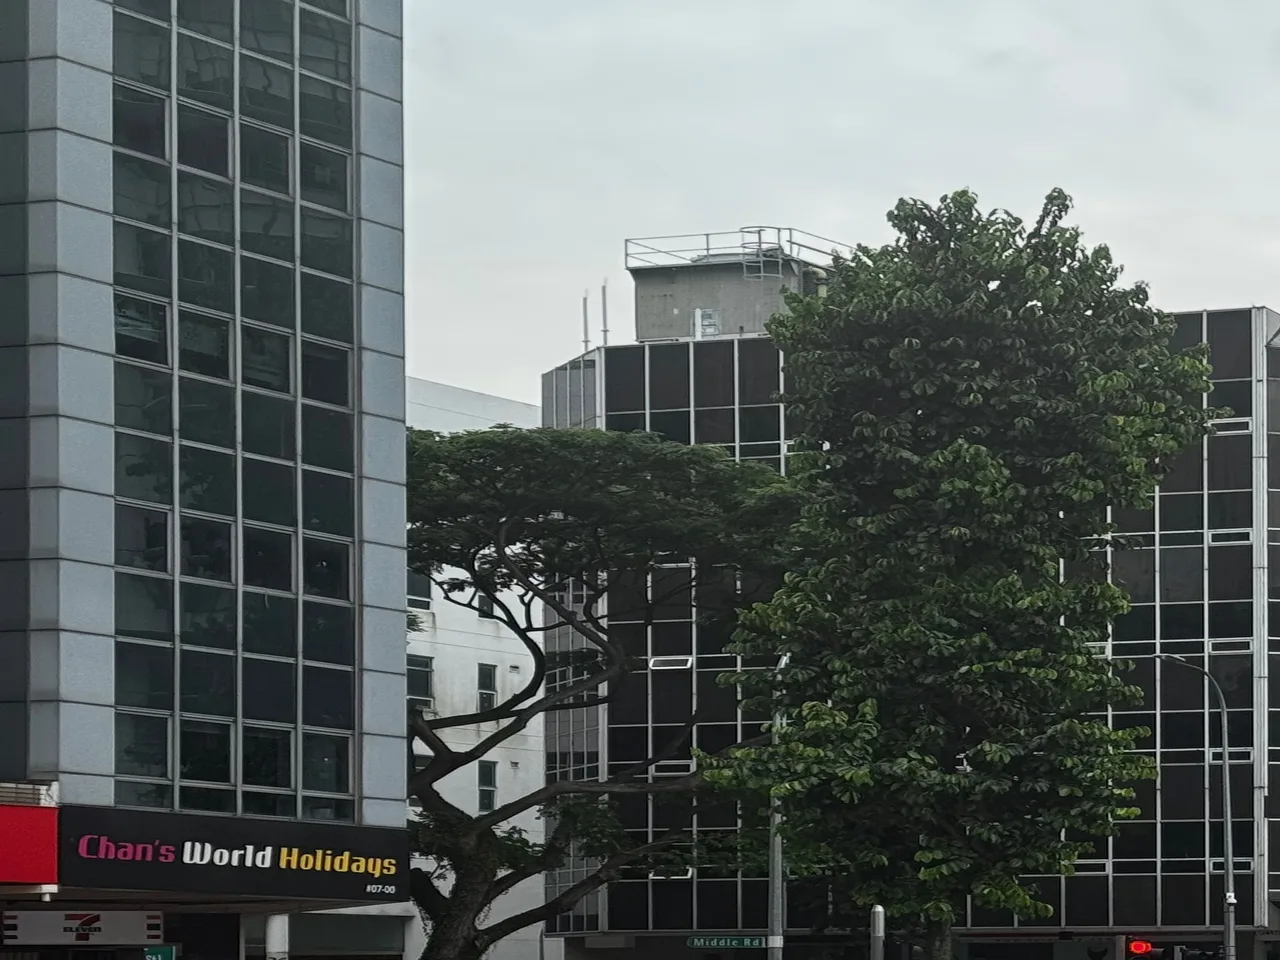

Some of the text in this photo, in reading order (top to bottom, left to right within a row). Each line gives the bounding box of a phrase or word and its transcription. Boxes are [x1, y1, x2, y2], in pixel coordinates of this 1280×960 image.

[77, 834, 396, 878] Chan's World Holidays
[366, 884, 396, 895] #07-00
[693, 938, 738, 946] Middle
